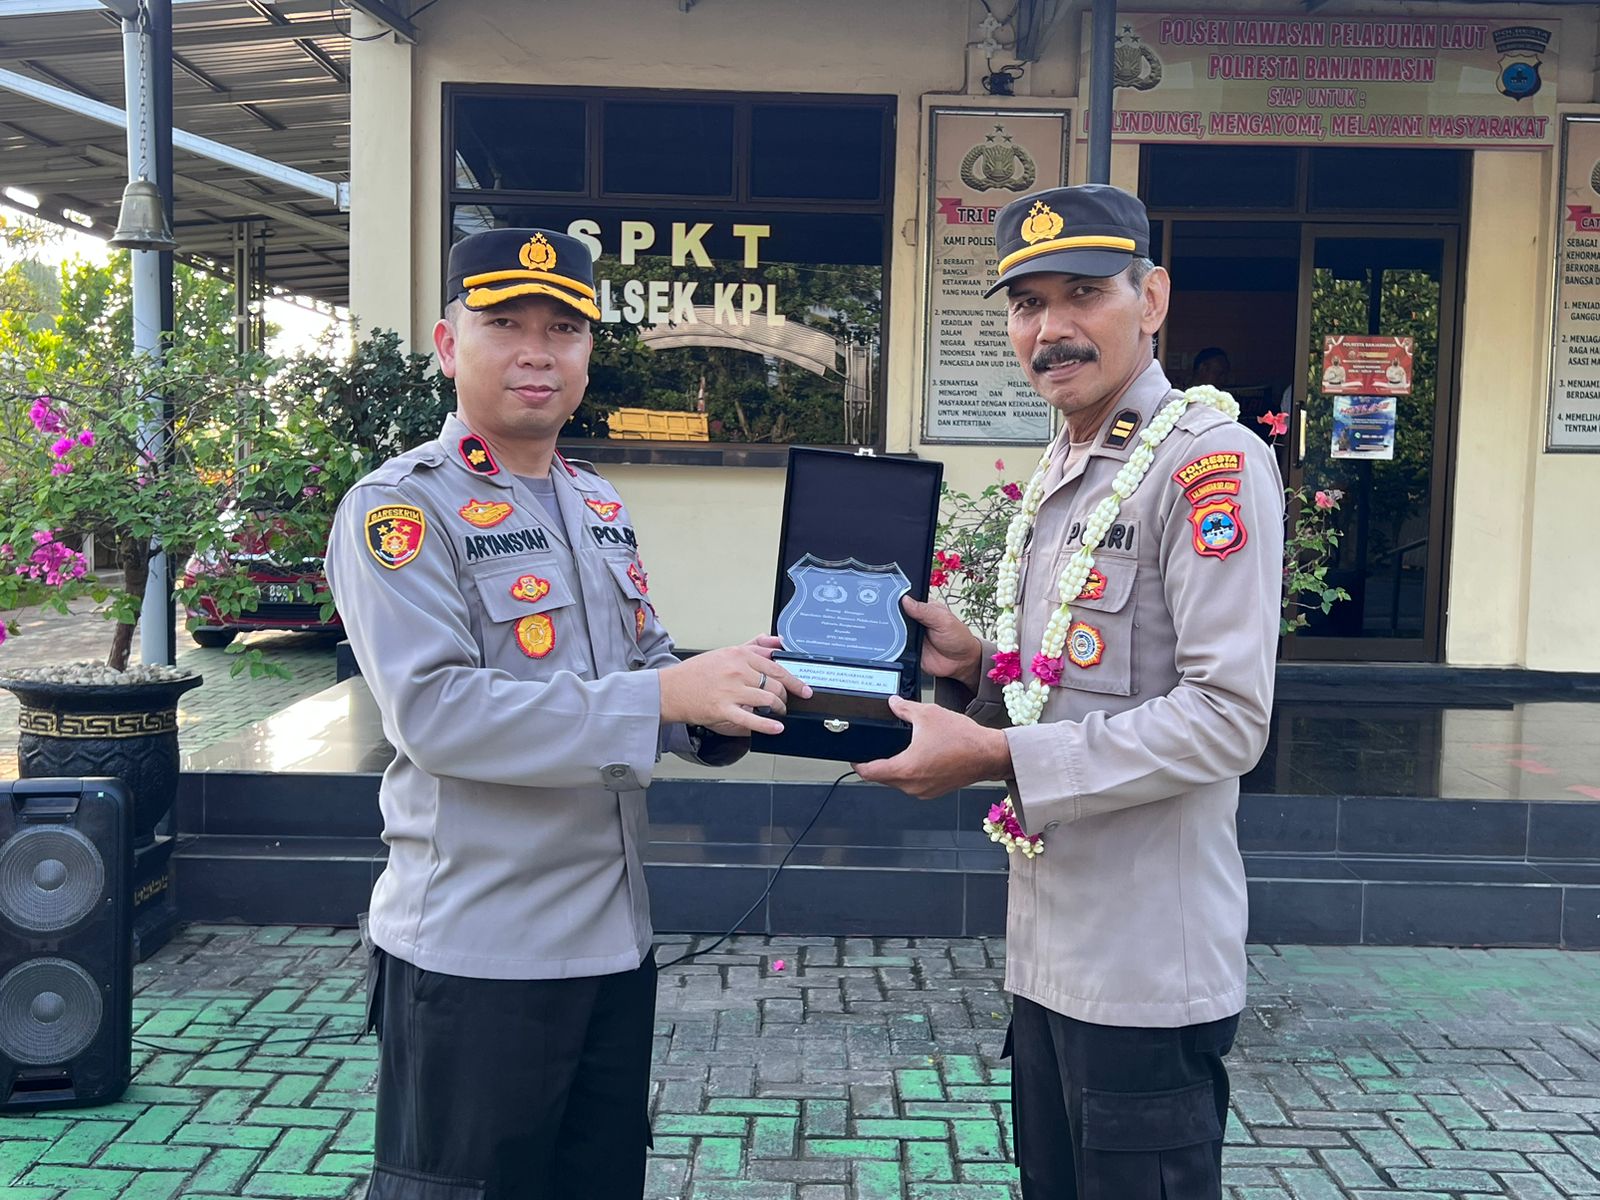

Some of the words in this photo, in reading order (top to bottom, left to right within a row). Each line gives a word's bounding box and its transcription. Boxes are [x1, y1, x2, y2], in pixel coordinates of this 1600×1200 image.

[1161, 19, 1229, 45] POLSEK
[1234, 20, 1324, 46] KAWASAN
[1331, 22, 1436, 47] PELABUHAN
[1441, 24, 1487, 48] LAUT
[1208, 55, 1299, 80] POLRESTA
[1304, 56, 1435, 81] BANJARMASIN
[1268, 88, 1302, 106] SIAP
[1306, 88, 1357, 107] UNTUK
[1085, 111, 1206, 138] LINDUNGI,
[1209, 112, 1326, 140] MENGAYOMI,
[1331, 115, 1423, 137] MELAYANI
[1428, 116, 1549, 139] MASYARAKAT
[957, 208, 983, 222] TRI
[943, 236, 966, 246] KAMI
[1567, 238, 1598, 248] SEBAGAI
[1565, 276, 1597, 285] BANGSA
[600, 279, 699, 325] LSEK
[714, 282, 786, 327] KPL
[942, 309, 984, 317] MENJUNJUNG
[1568, 346, 1588, 354] RAGA
[939, 359, 974, 367] PANCASILA
[1568, 357, 1589, 366] ASASI
[937, 419, 951, 427] DAN
[1565, 424, 1597, 432] TENTRAM
[1179, 454, 1238, 479] POLRESTA
[371, 508, 420, 521] BARESKRIM
[1066, 522, 1135, 551] PRI
[464, 527, 550, 561] ARYANSYAH
